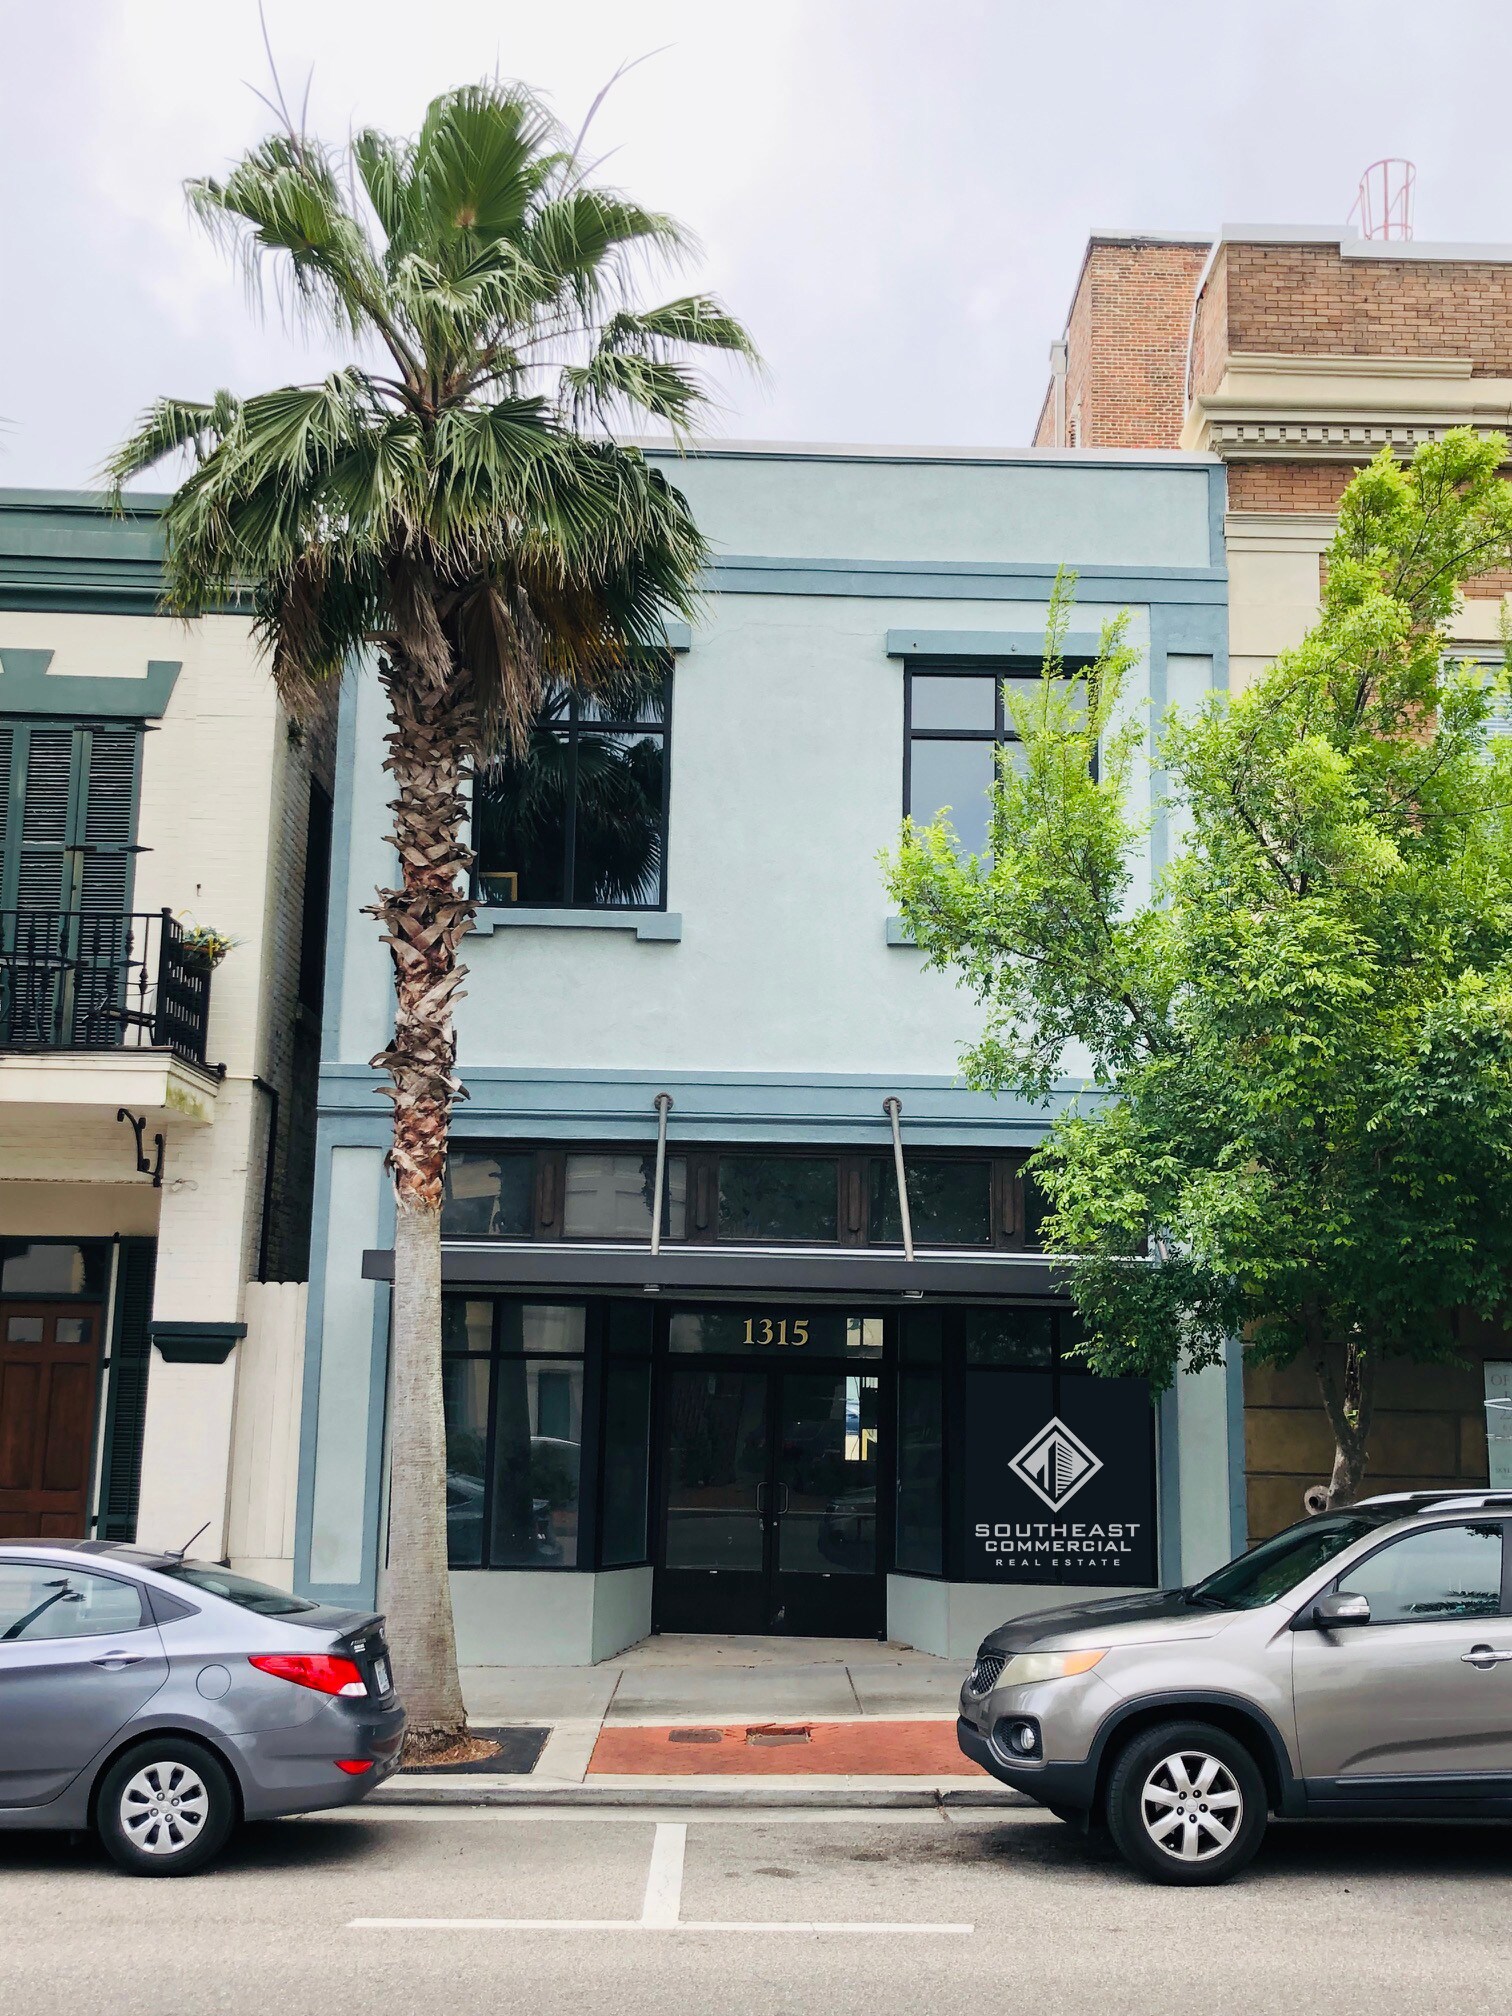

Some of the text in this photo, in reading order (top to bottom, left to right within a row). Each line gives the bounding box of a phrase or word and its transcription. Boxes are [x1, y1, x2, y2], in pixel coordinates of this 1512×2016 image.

[743, 1319, 808, 1345] 1315
[975, 1524, 1140, 1537] SOUTHEAST
[986, 1541, 1131, 1551] COMMERCIAL
